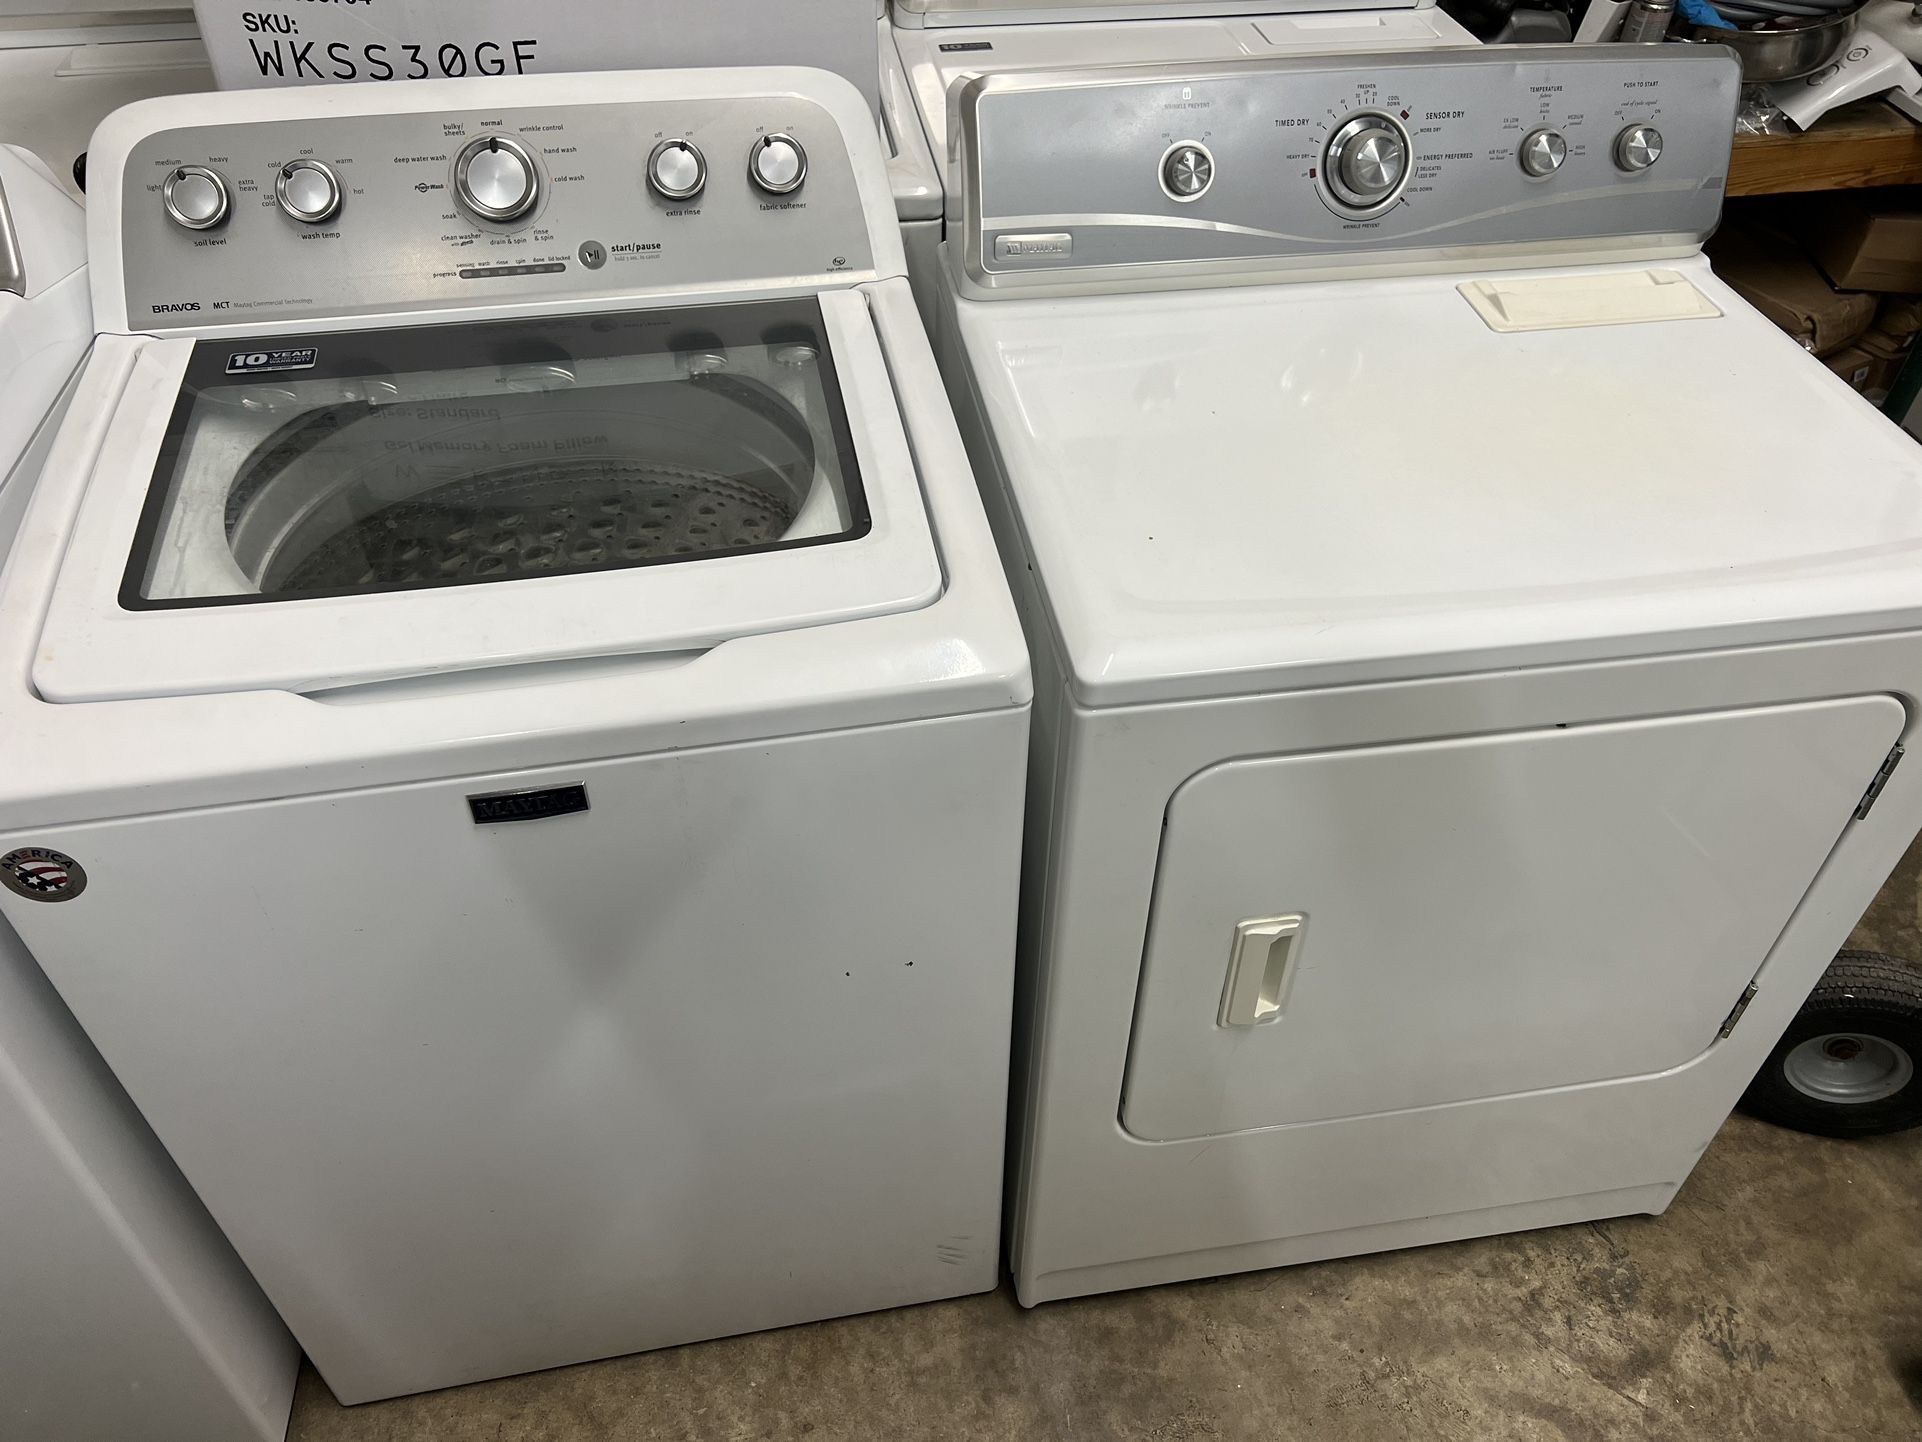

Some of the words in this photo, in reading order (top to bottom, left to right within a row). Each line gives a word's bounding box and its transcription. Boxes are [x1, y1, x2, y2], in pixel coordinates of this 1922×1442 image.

[242, 12, 300, 34] SKU:
[248, 38, 538, 81] WKSS30GF
[1425, 111, 1451, 120] SENSOR
[1452, 110, 1465, 119] DRY
[443, 122, 464, 131] bulky/
[1275, 119, 1295, 127] TIMED
[1296, 118, 1310, 126] DRY
[394, 156, 410, 164] deep
[1423, 153, 1443, 161] ENERGY
[1444, 152, 1473, 160] PREFERRED
[263, 193, 275, 201] tap
[759, 202, 779, 211] fabric
[780, 202, 807, 210] softener
[666, 209, 683, 217] extra
[684, 208, 701, 216] rinse
[302, 232, 320, 240] wash
[322, 231, 341, 240] temp
[459, 232, 482, 240] washer
[540, 234, 554, 242] spin
[194, 239, 207, 247] soil
[210, 238, 227, 246] level
[514, 237, 527, 245] spin
[611, 242, 662, 253] start/pause
[152, 302, 201, 313] BRAVOS
[213, 301, 231, 310] MCT
[234, 353, 268, 367] 10
[271, 350, 313, 358] YEAR
[1, 849, 73, 869] AMERICA
